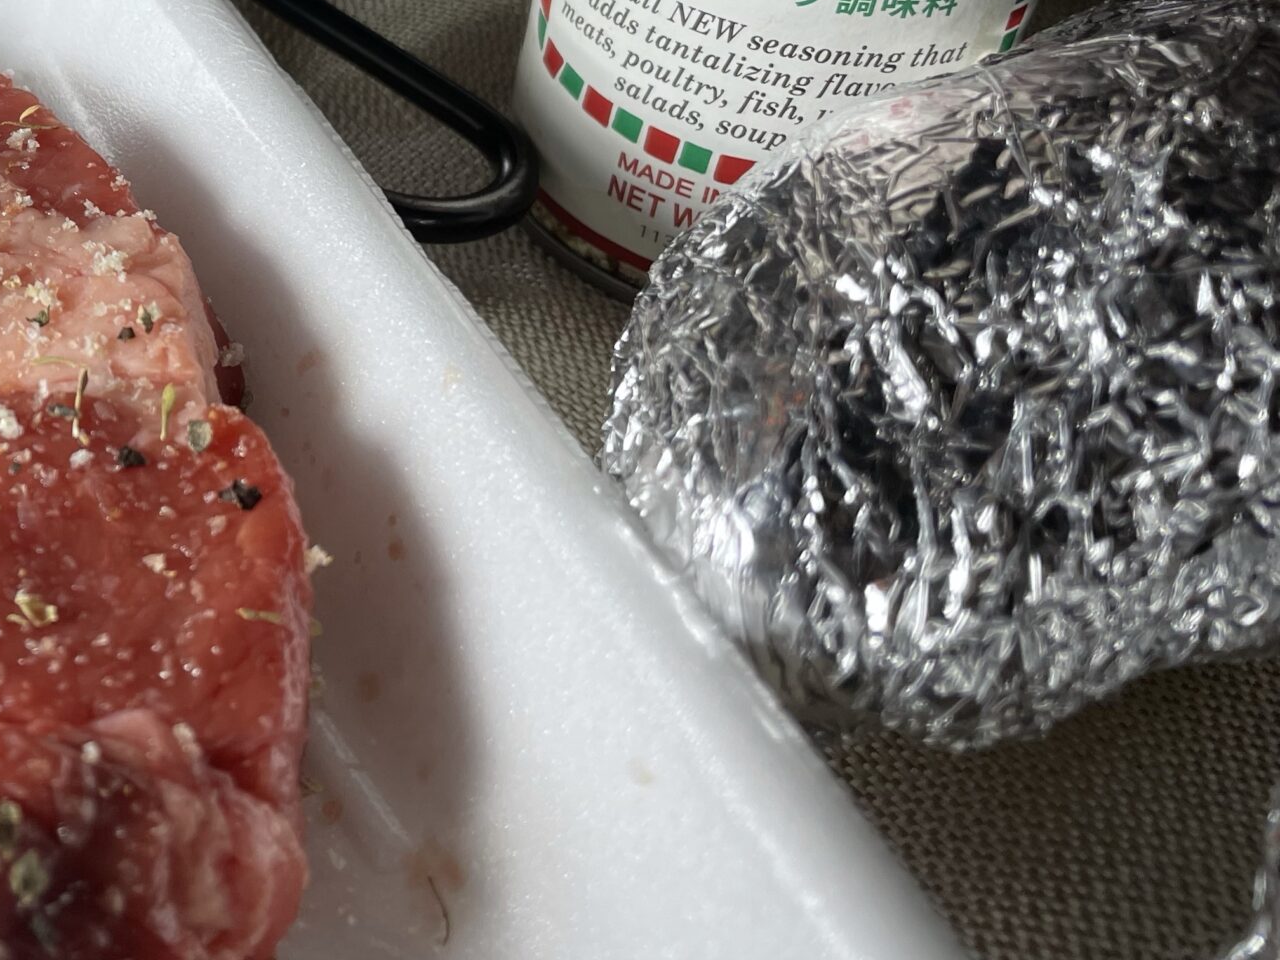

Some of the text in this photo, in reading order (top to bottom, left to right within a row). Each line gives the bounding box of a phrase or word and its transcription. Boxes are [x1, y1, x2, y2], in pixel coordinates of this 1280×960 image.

[561, 0, 804, 125] meats, poultry, fish,
[645, 25, 814, 97] tantalizing
[815, 72, 896, 99] flav
[667, 0, 748, 44] NEW
[746, 34, 906, 74] seasoning
[909, 41, 969, 68] that
[613, 74, 788, 151] salads, soup
[607, 174, 702, 228] NET W
[617, 151, 696, 199] MADE
